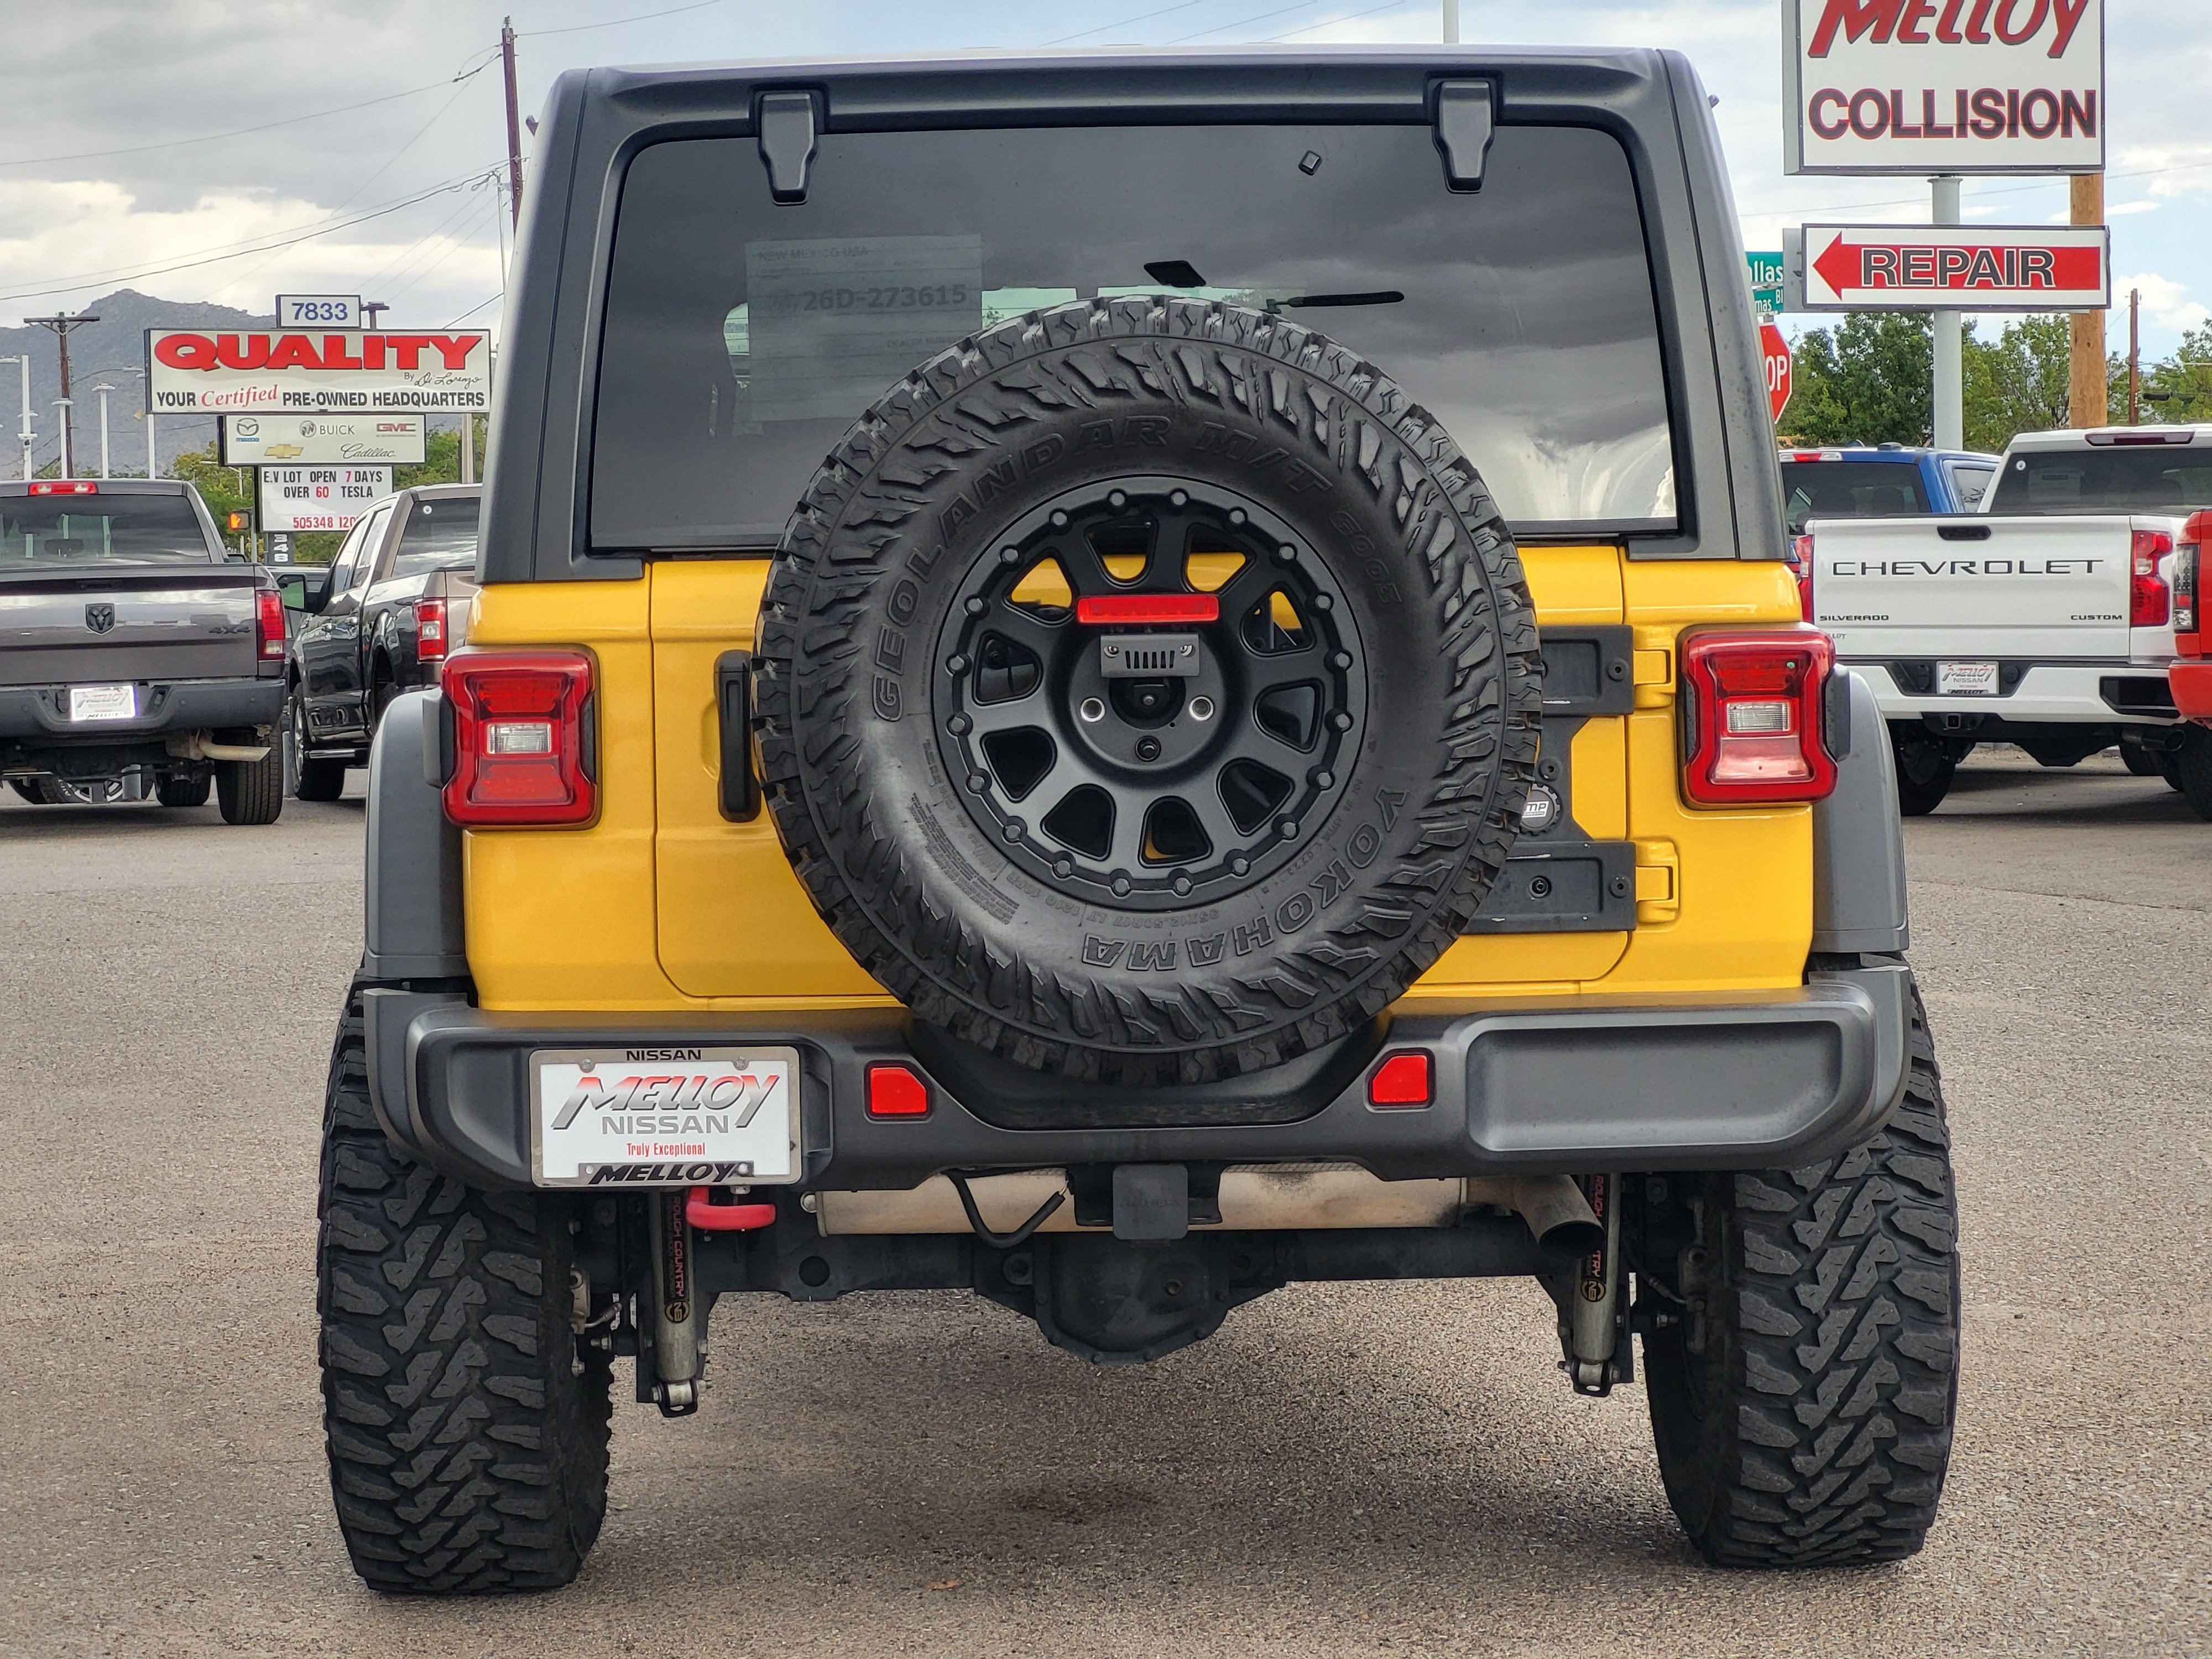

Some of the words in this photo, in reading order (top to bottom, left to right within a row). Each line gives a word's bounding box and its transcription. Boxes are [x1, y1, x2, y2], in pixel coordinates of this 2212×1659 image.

[1807, 0, 2089, 58] MELLOY
[1808, 88, 2096, 140] COLLISION
[1749, 260, 1783, 283] llas
[1860, 247, 2057, 288] REPAIR
[803, 284, 967, 311] 26D-273615
[1755, 299, 1772, 312] mas
[1775, 289, 1783, 304] Bl
[291, 302, 348, 321] 7833
[154, 333, 484, 372] QUALITY
[404, 372, 414, 382] By
[1765, 354, 1788, 393] OP
[156, 392, 196, 407] YOUR
[201, 384, 279, 408] Certified
[283, 391, 368, 407] PRE-OWNED
[372, 390, 485, 408] HEADQUARTERS
[320, 425, 355, 435] BUICK
[376, 423, 416, 432] GMC
[340, 443, 395, 459] Cadillac
[263, 471, 279, 483] E.V
[283, 471, 302, 483] LOT
[309, 471, 337, 483] OPEN
[345, 470, 352, 483] 7
[354, 470, 383, 483] DAYS
[284, 486, 309, 498] OVER
[315, 486, 329, 498] 60
[341, 486, 374, 498] TESLA
[293, 516, 333, 529] 505348
[338, 516, 358, 529] 120
[1832, 559, 2104, 577] CHEVROLET
[1942, 667, 1995, 682] MELLOY
[1082, 784, 1410, 972] YOKOHAMA
[626, 1049, 702, 1061] NISSAN
[550, 1074, 780, 1131] MELLOY
[602, 1115, 729, 1134] NISSAN
[626, 1142, 650, 1157] Truly
[653, 1141, 706, 1157] Exceptional
[588, 1162, 737, 1185] MELLOY
[672, 1196, 682, 1237] ROUGH
[674, 1240, 685, 1297] COUNTRY
